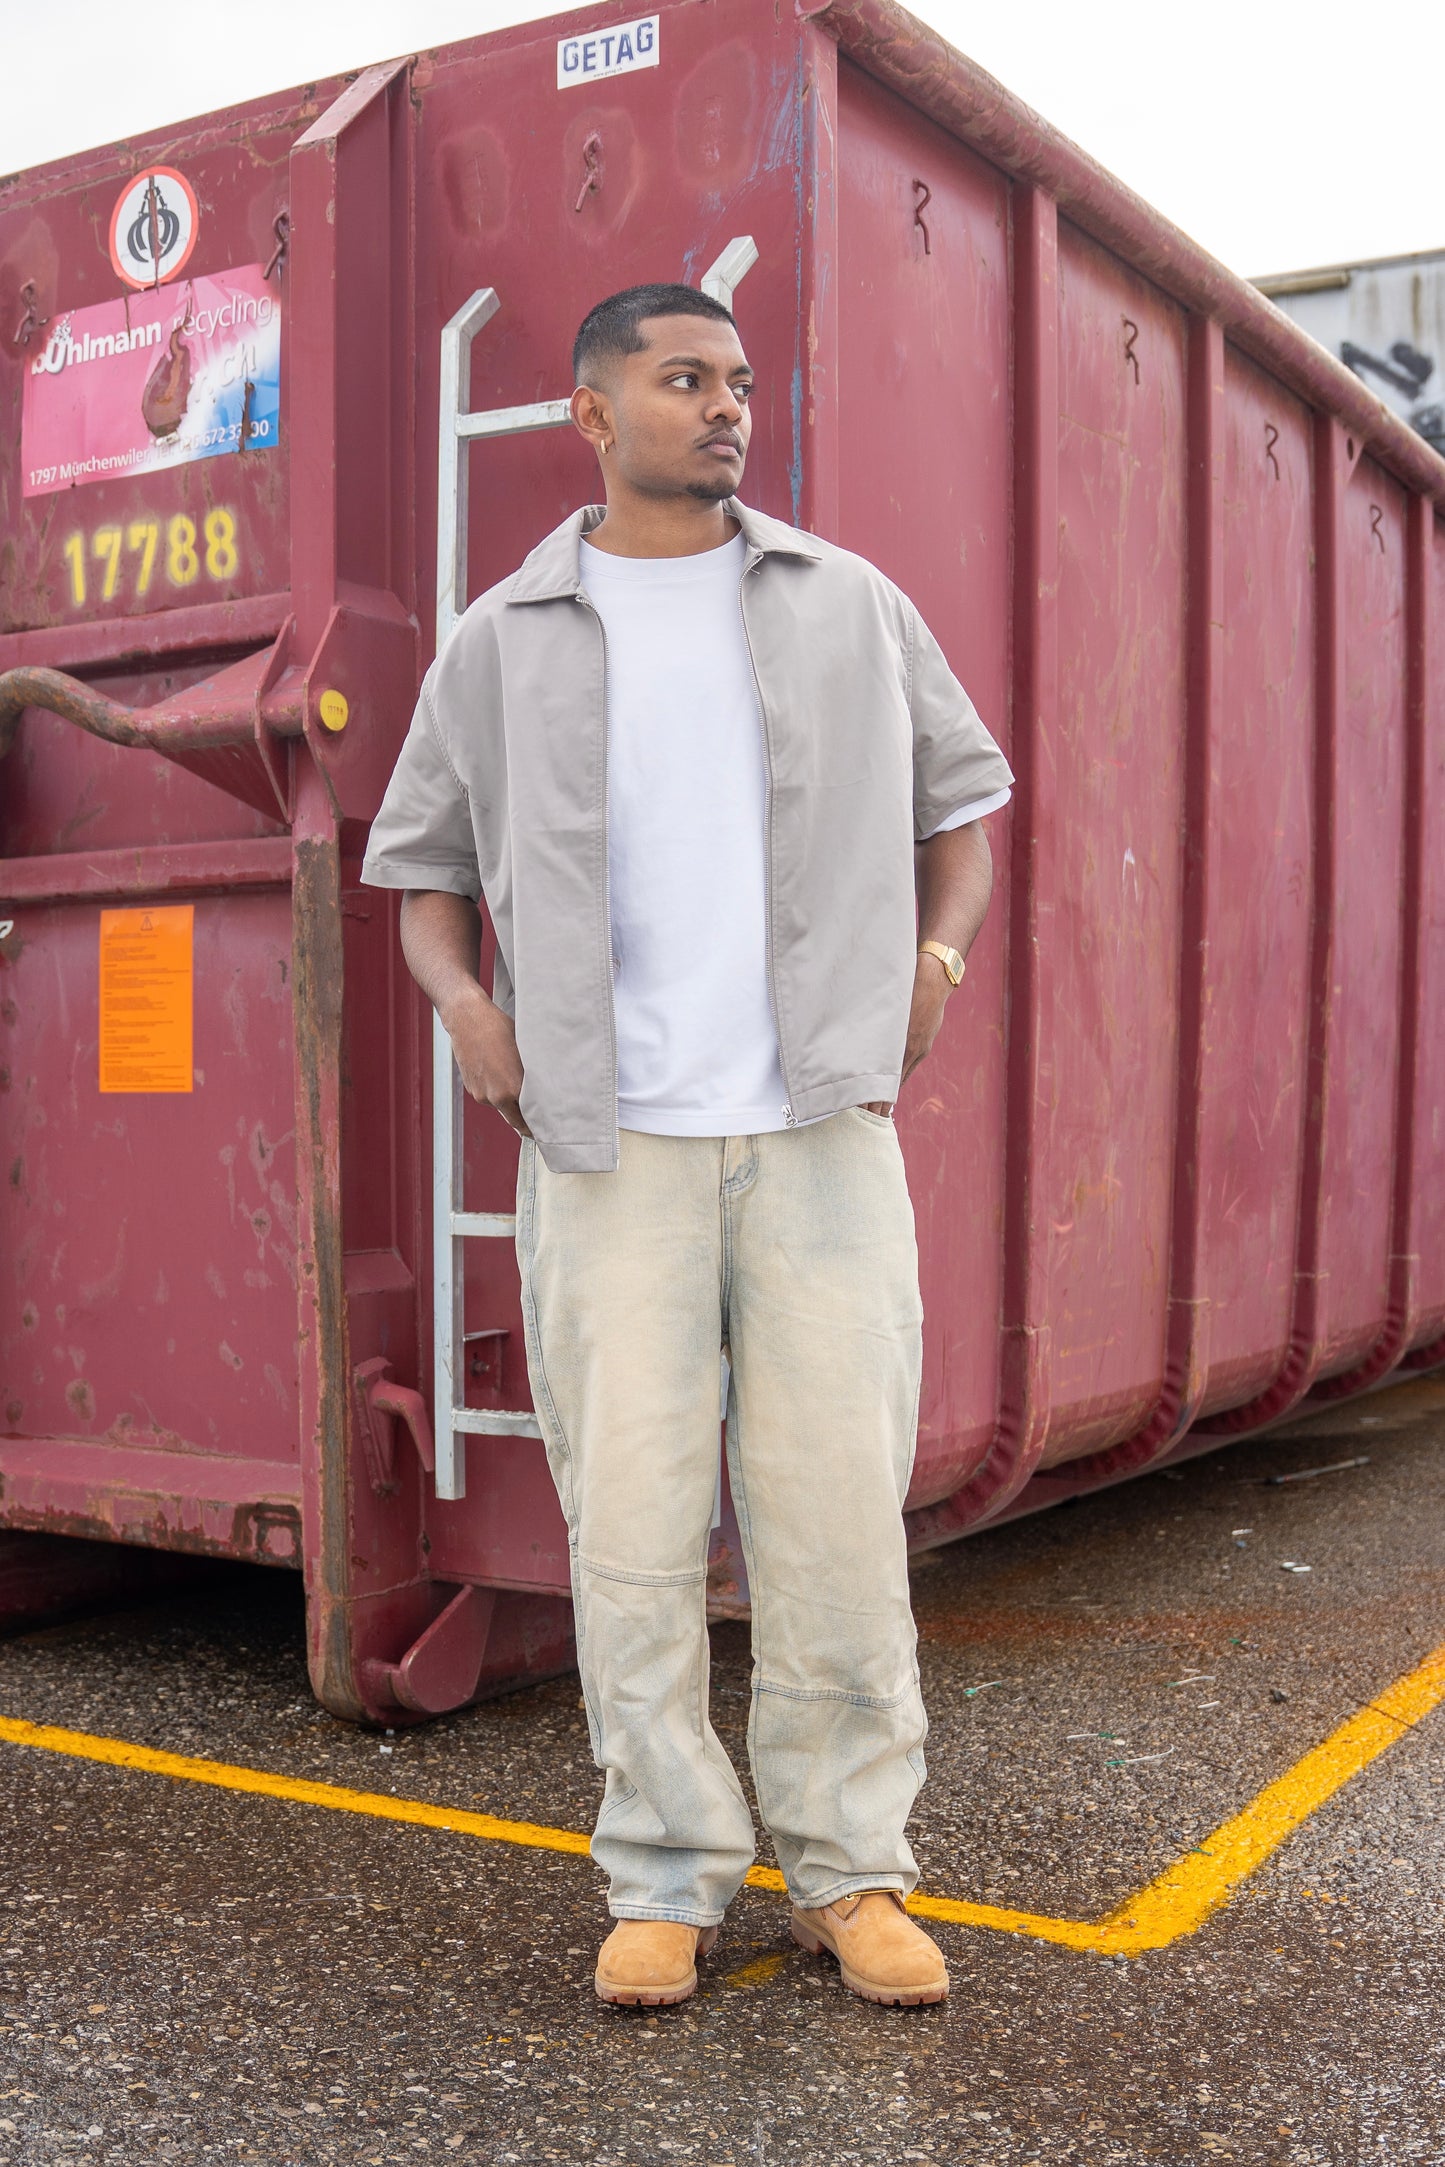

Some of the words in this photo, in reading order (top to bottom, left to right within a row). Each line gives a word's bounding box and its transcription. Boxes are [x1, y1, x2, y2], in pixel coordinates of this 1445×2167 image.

[563, 22, 653, 73] GETAG
[29, 465, 57, 487] 1797
[202, 427, 226, 447] 672
[64, 509, 238, 606] 17788
